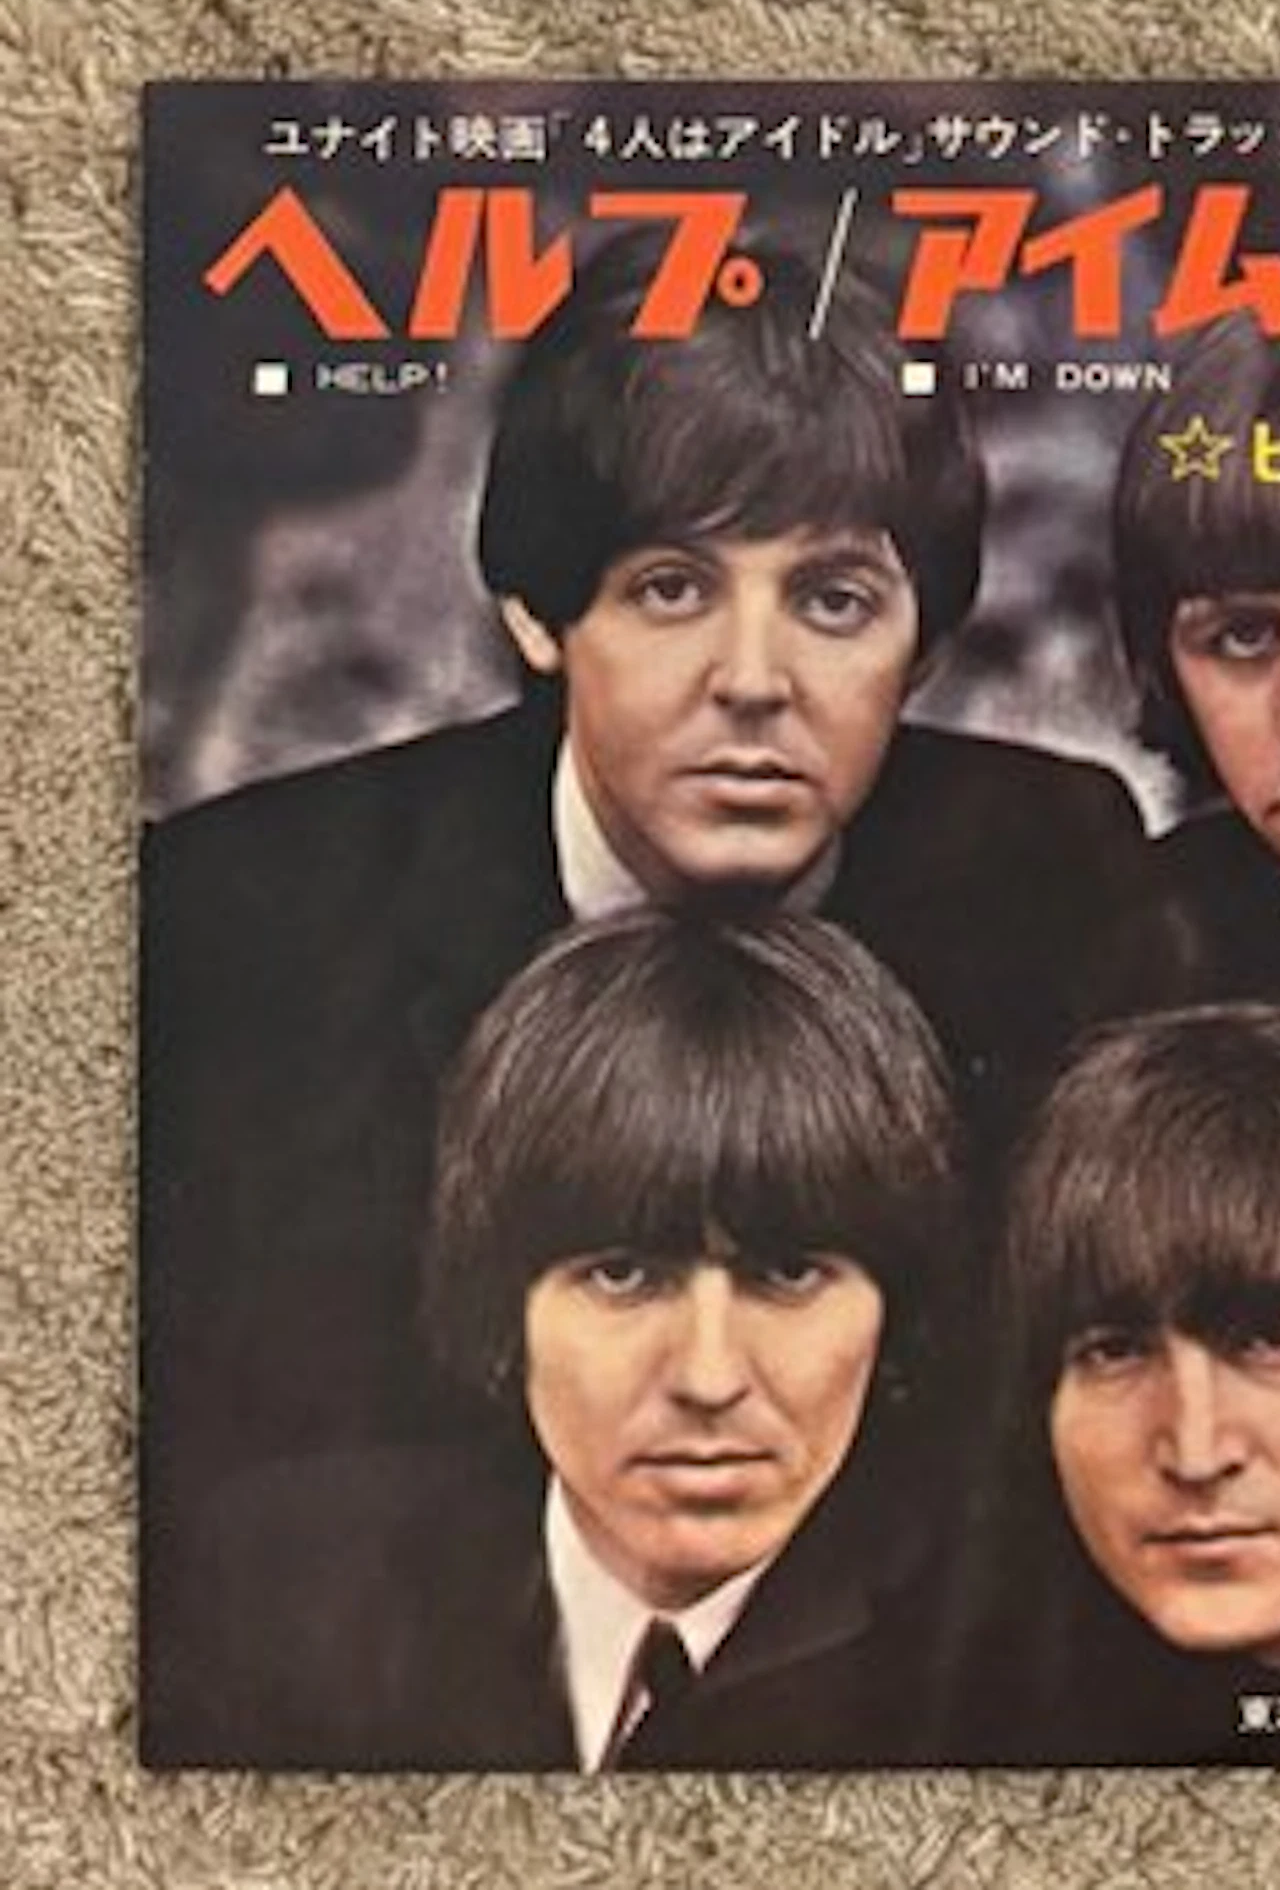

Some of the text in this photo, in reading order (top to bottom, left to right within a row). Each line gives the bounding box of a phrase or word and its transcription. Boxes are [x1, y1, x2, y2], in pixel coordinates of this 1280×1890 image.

[314, 361, 449, 396] HELP!
[962, 361, 1172, 393] I'M DOWN
